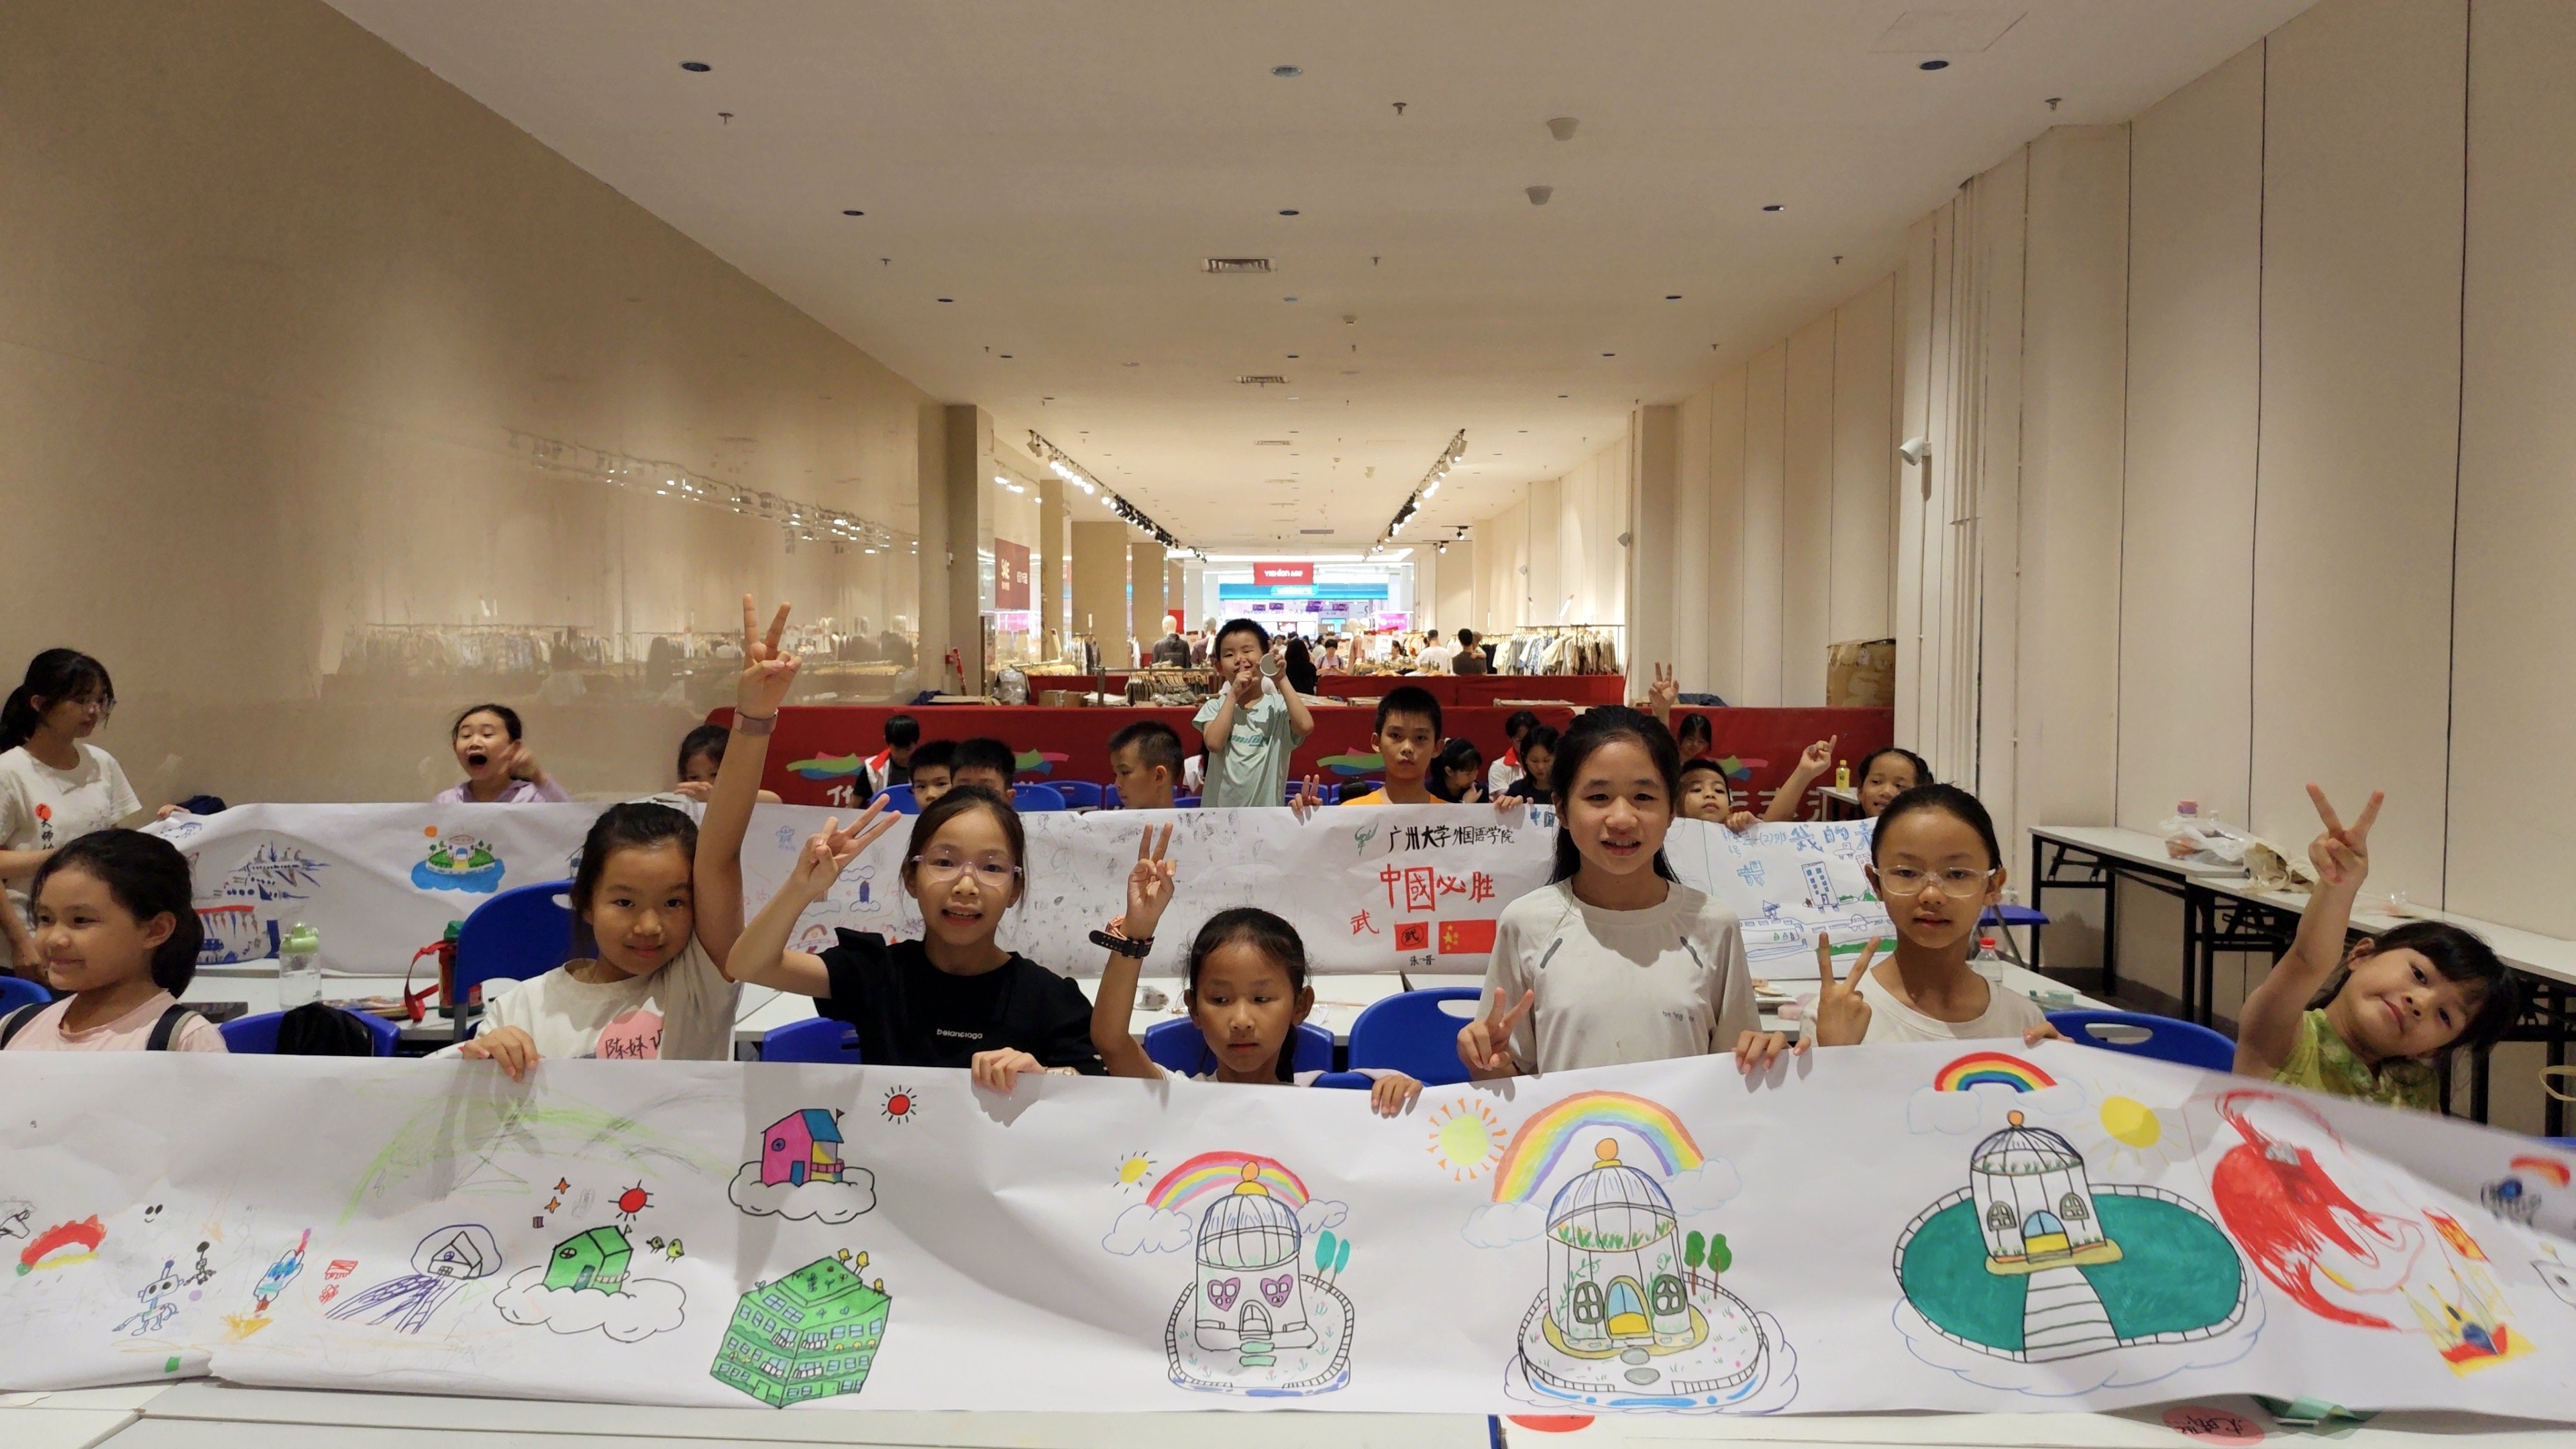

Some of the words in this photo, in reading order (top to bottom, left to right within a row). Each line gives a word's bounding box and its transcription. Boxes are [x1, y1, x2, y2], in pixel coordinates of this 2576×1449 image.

[1388, 824, 1515, 853] 广州大学外国语学院
[1380, 863, 1495, 913] 中國必胜
[1350, 908, 1380, 935] 武
